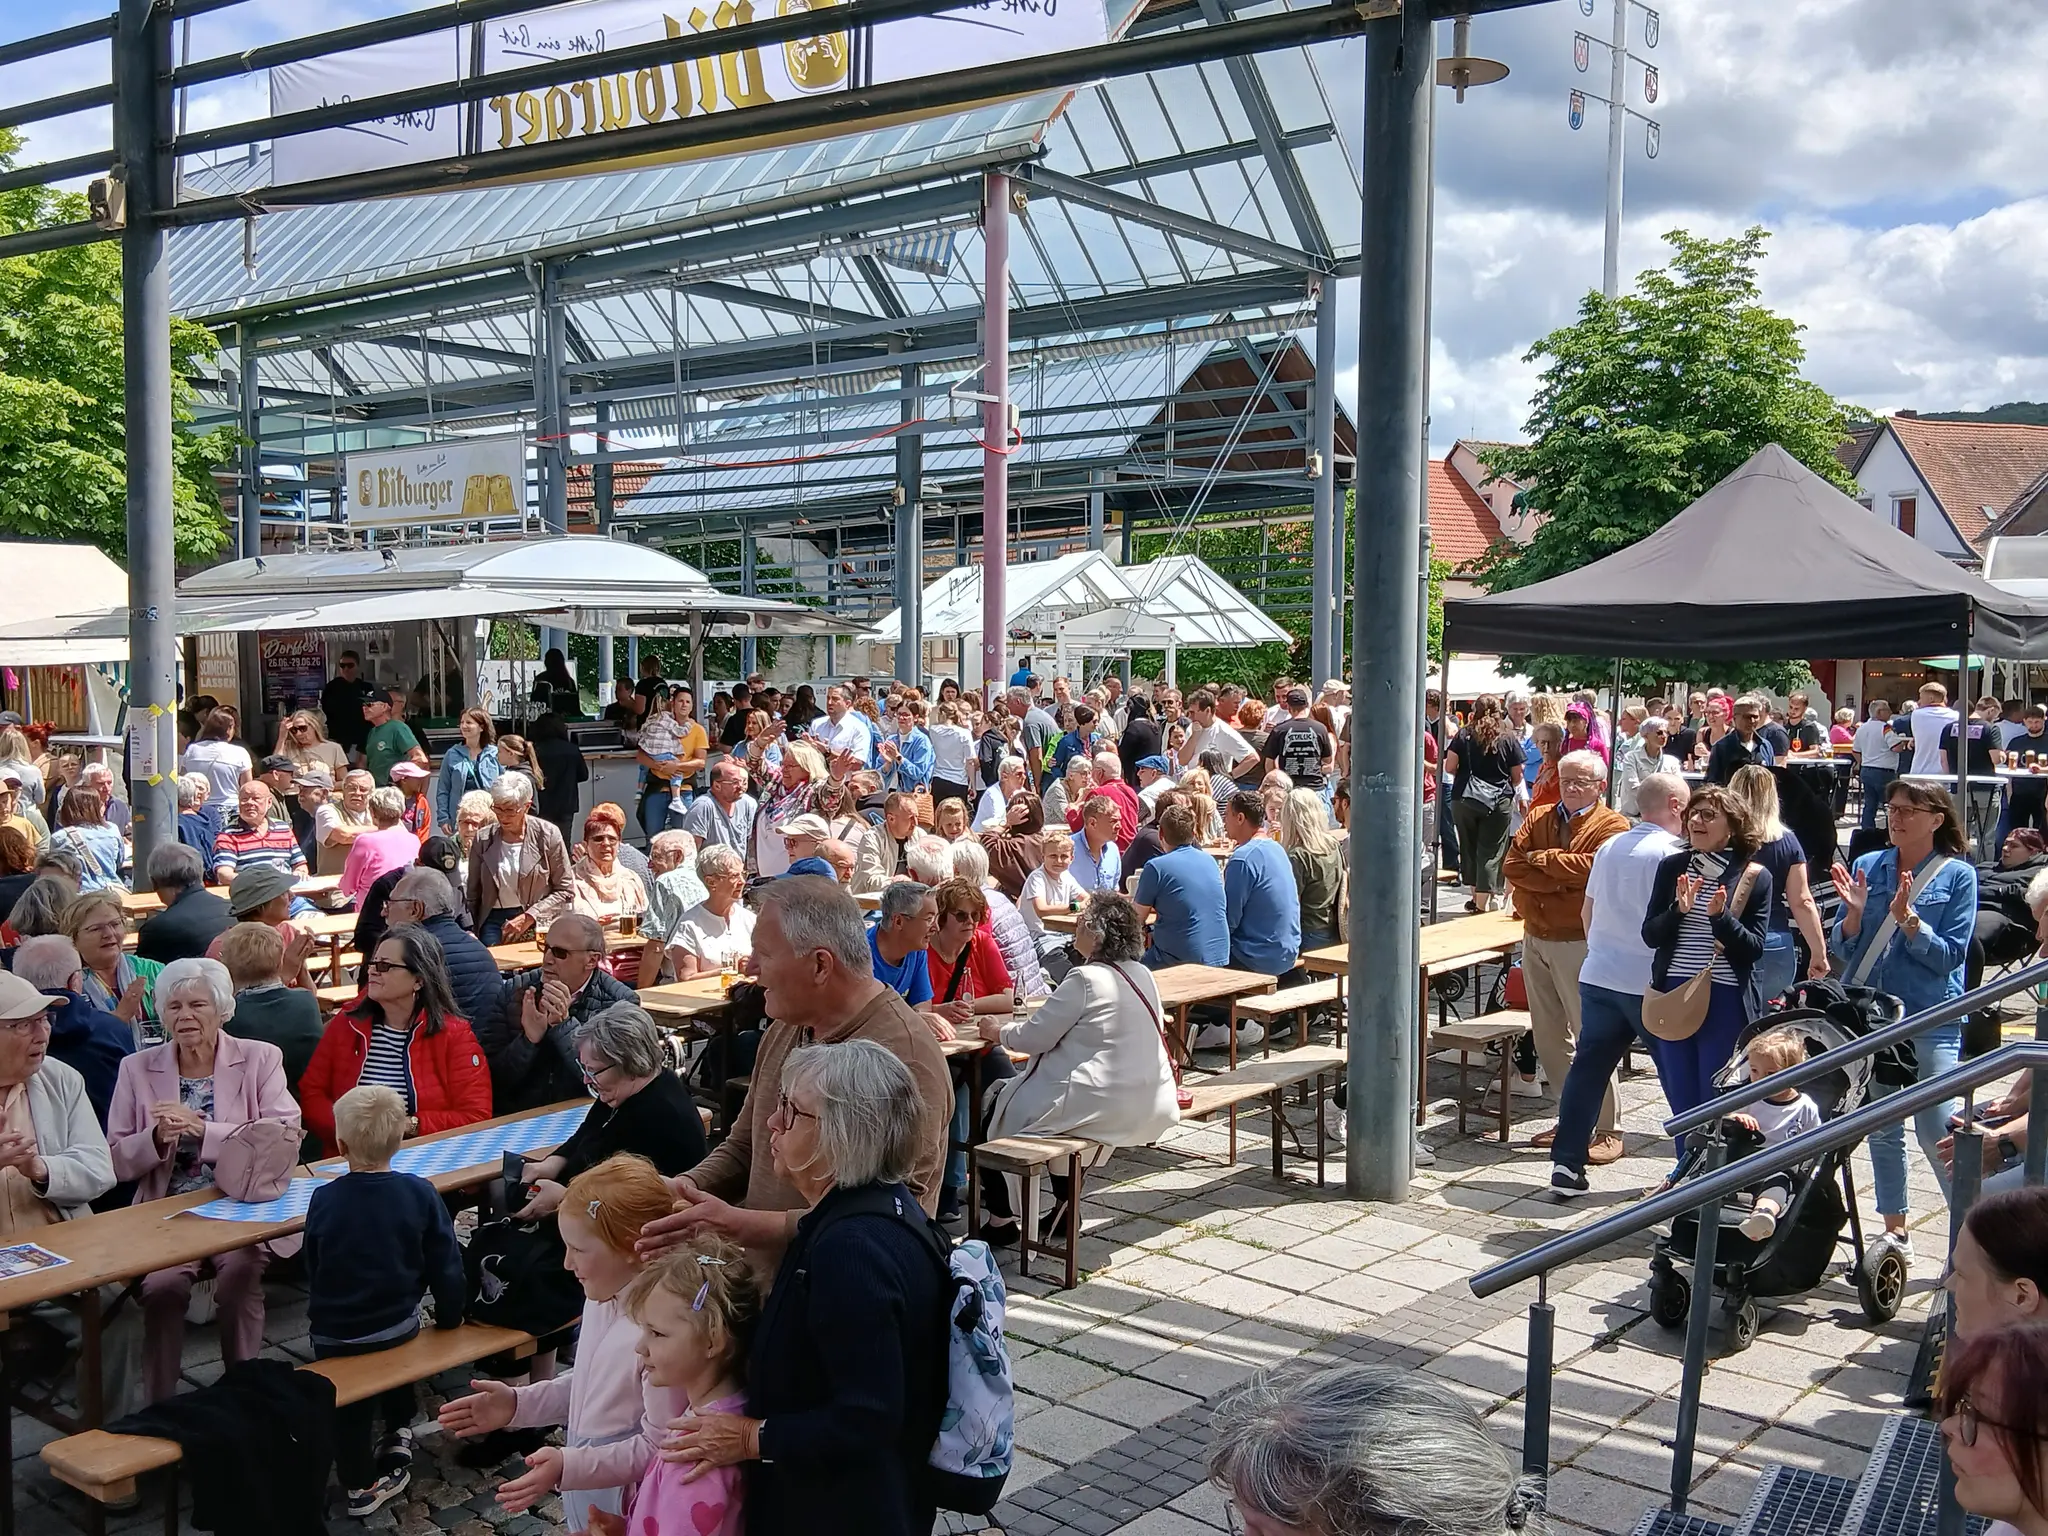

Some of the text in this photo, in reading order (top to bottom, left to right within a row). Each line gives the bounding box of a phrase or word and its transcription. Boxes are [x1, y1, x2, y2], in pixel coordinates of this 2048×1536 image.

[377, 465, 454, 511] Bitburger
[264, 638, 319, 659] Dorffest
[200, 659, 236, 676] SCHMECKEN
[200, 677, 237, 689] LASSEN
